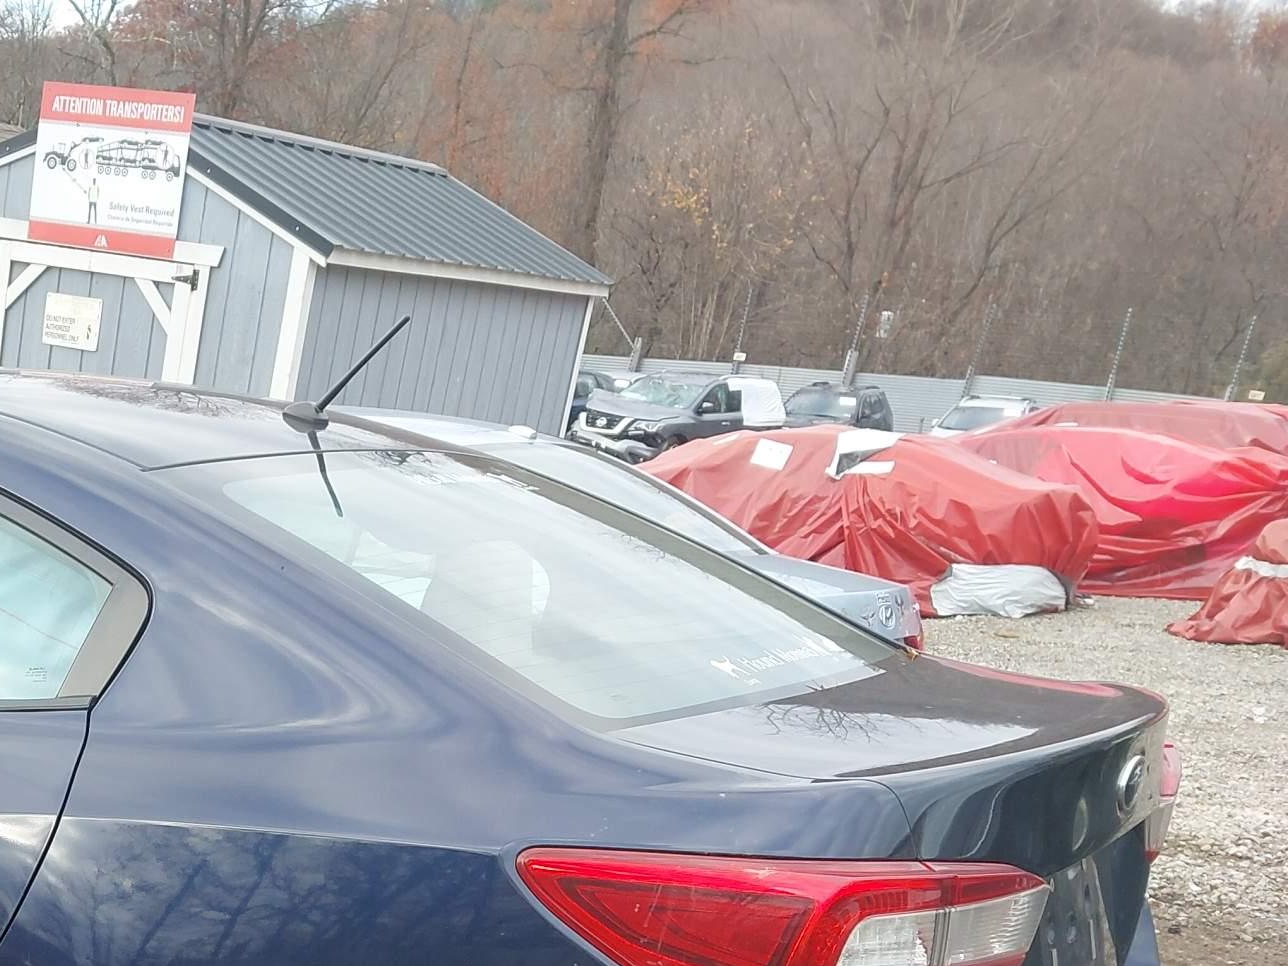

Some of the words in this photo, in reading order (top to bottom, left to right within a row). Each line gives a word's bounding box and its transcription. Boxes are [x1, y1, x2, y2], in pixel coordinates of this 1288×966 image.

[52, 96, 103, 116] ATTENTION
[105, 99, 185, 123] TRANSPORTERS!
[109, 201, 129, 214] Safety
[130, 203, 144, 213] Vest
[145, 206, 175, 218] Required
